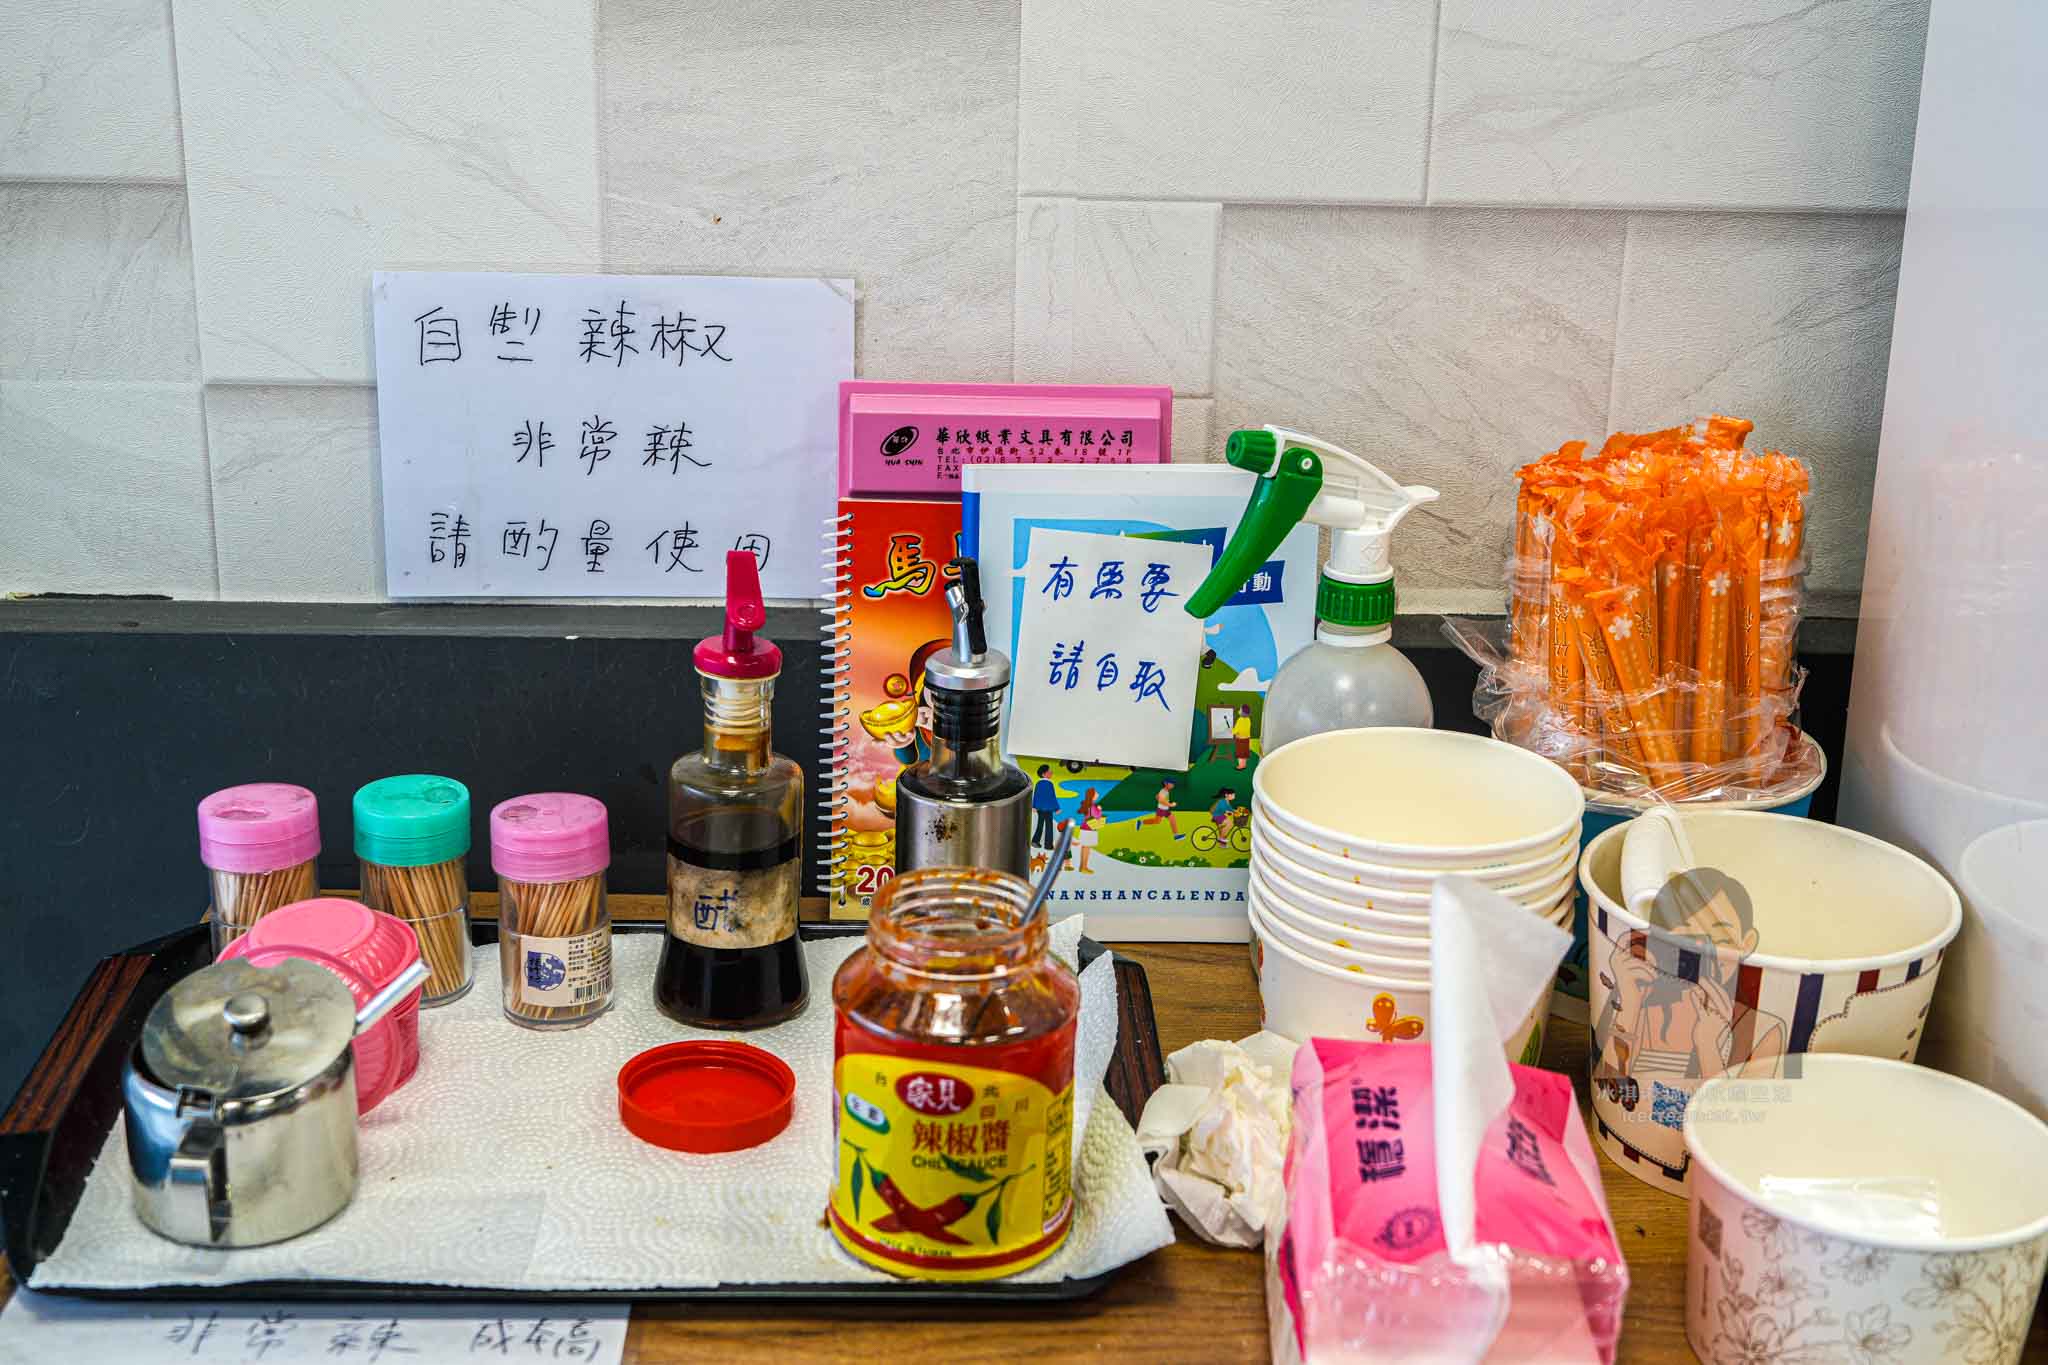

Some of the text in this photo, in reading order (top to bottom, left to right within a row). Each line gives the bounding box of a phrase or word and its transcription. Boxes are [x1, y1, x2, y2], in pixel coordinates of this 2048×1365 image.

[1048, 640, 1172, 712] 請自取
[912, 1120, 1009, 1156] 辣椒醬
